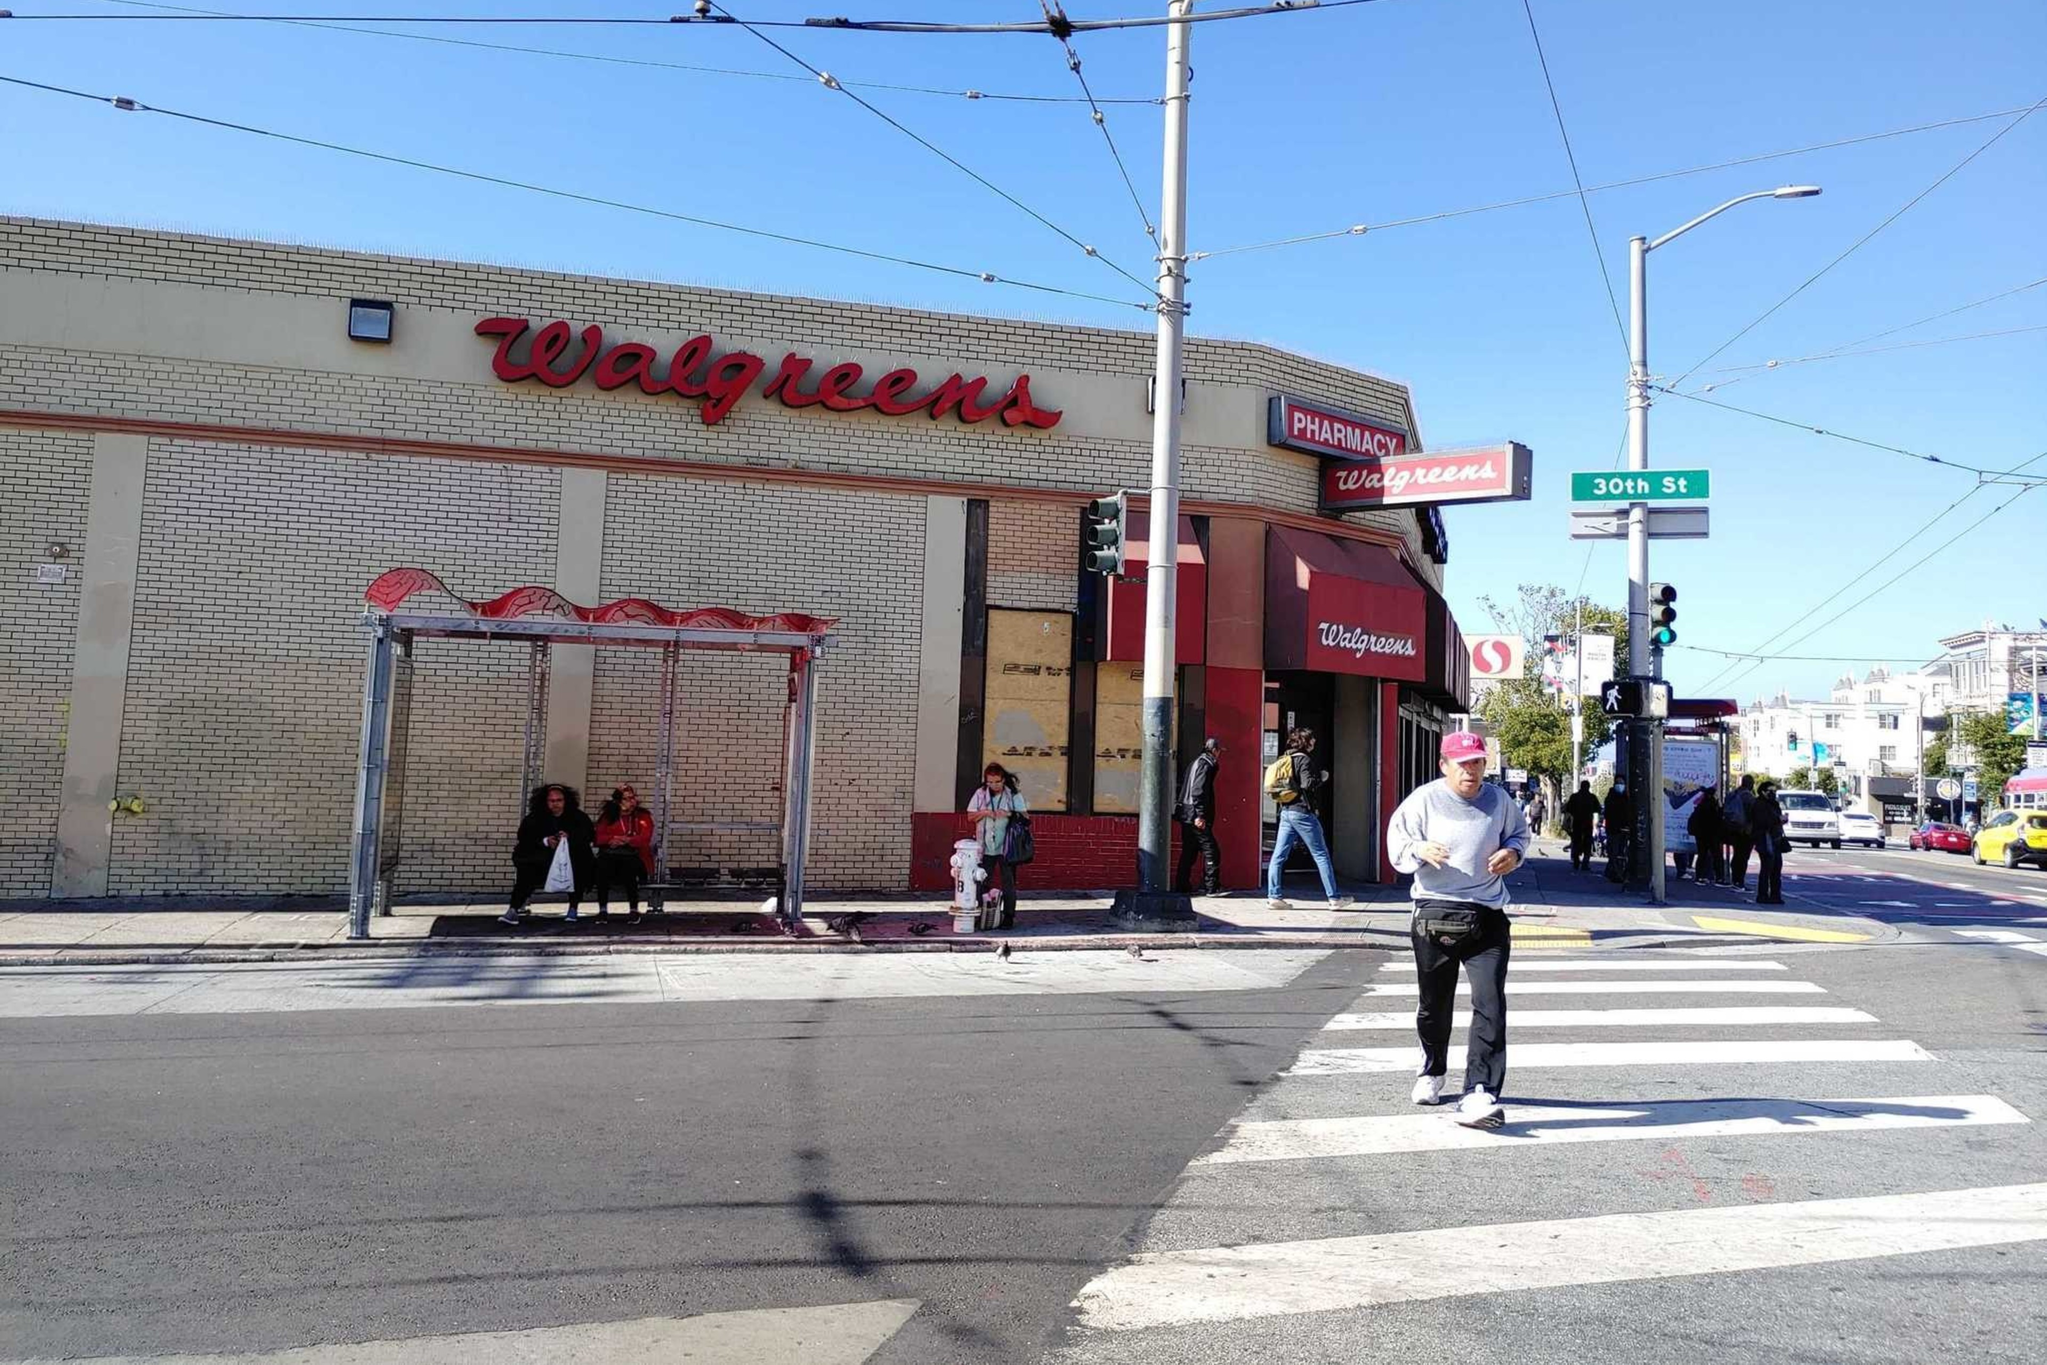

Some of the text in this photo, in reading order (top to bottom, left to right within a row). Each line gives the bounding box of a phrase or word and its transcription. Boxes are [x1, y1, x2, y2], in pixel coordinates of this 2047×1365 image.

[474, 317, 1063, 426] Walgreens
[1293, 411, 1397, 457] PHARMACY
[1336, 460, 1497, 492] Walgreens
[1593, 476, 1688, 494] 30th St
[1319, 622, 1416, 658] Walgreens
